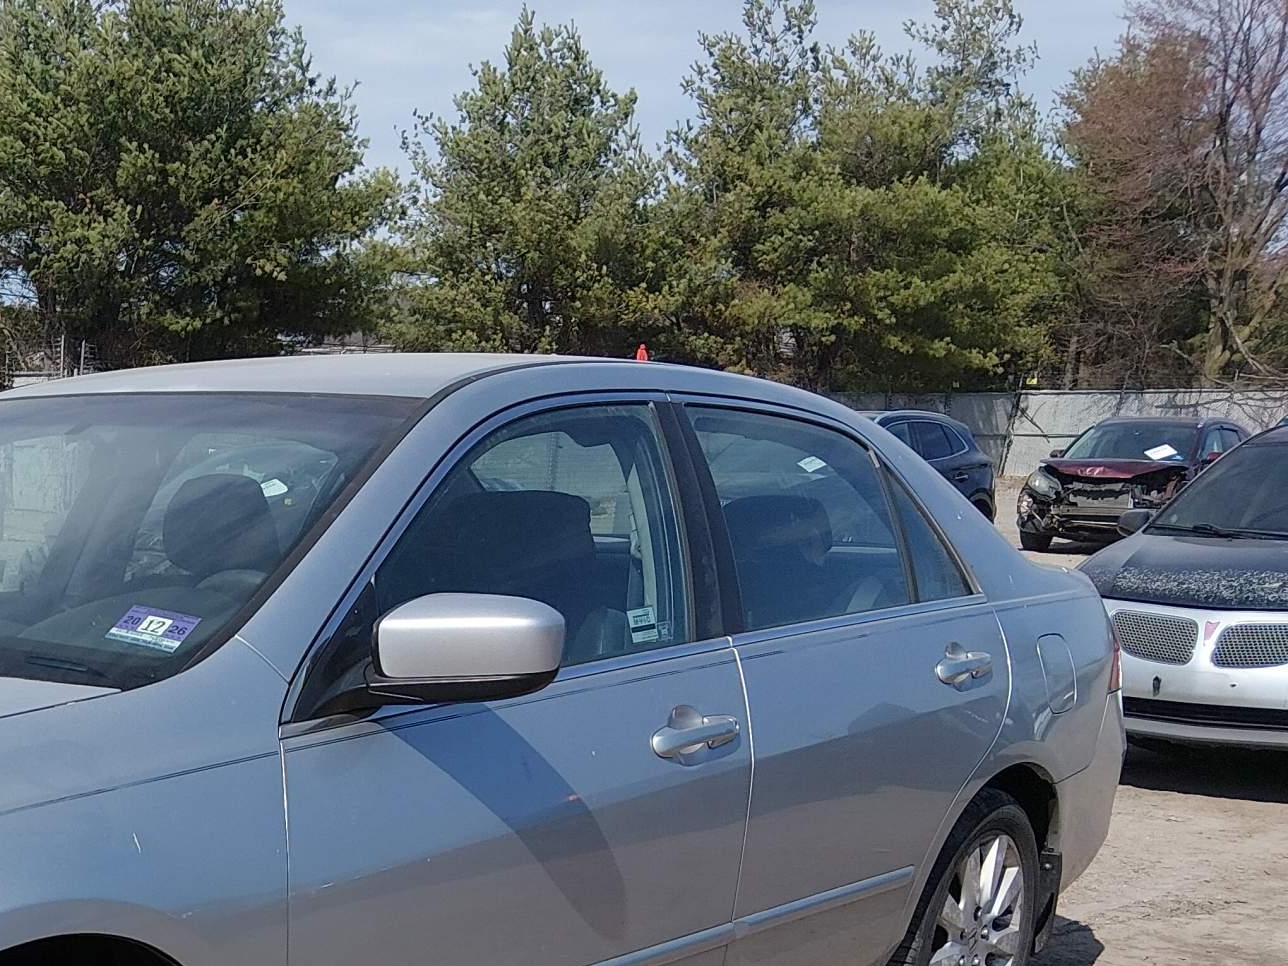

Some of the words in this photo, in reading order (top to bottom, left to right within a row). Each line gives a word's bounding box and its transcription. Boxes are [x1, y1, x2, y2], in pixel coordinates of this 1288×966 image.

[123, 615, 141, 625] 20
[141, 619, 166, 634] 12
[168, 625, 188, 635] 26
